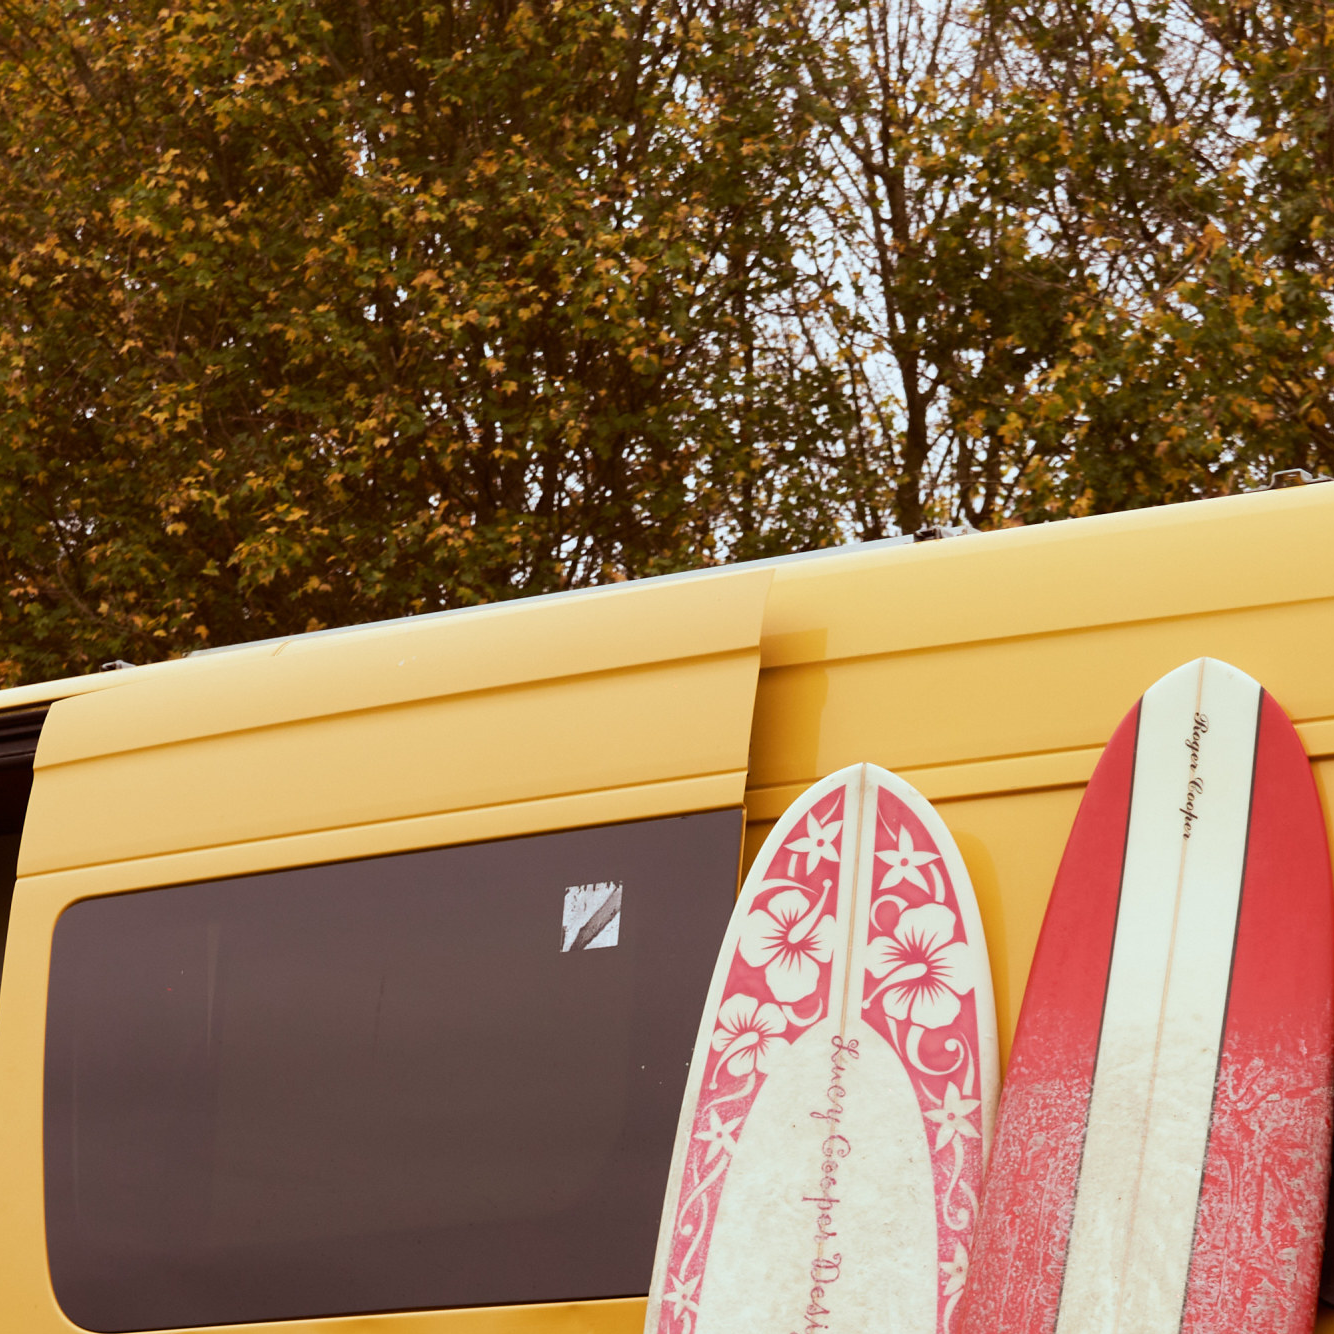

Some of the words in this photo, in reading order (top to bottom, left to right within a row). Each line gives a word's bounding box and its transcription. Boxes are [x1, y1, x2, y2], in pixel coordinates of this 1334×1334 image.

[1185, 712, 1209, 770] Roger
[1179, 777, 1204, 840] Cooper
[810, 1035, 860, 1124] Lucy
[802, 1133, 851, 1245] Cooper
